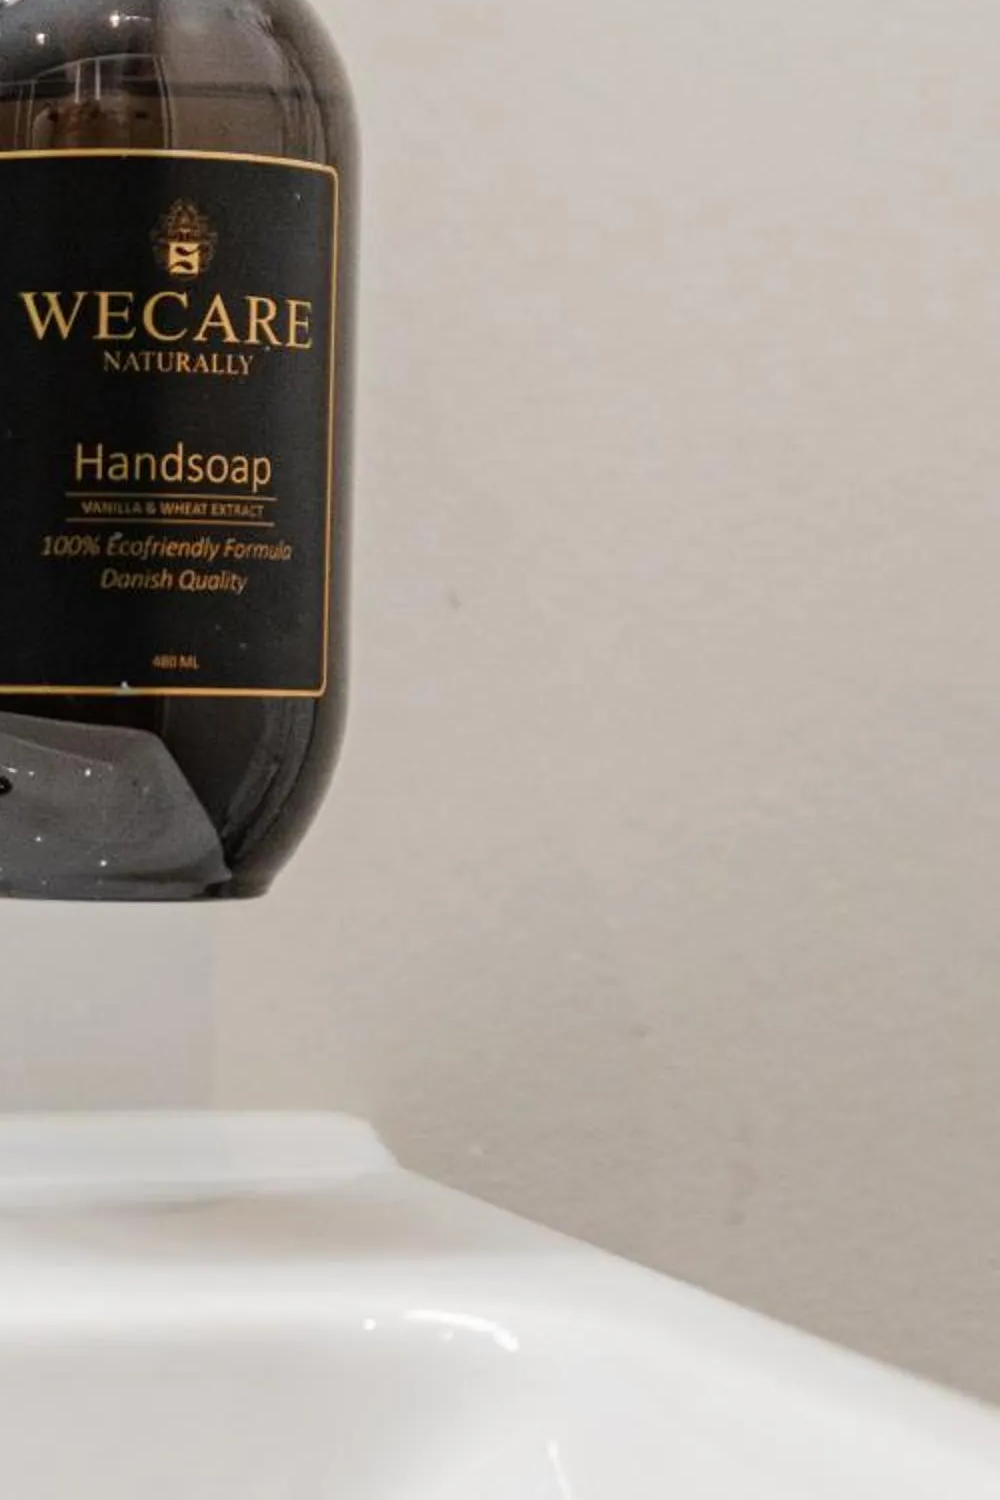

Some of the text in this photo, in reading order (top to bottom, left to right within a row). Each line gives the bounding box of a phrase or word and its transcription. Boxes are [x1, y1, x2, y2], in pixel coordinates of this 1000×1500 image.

[19, 291, 314, 349] WECARE
[103, 350, 254, 375] NATURALLY
[75, 441, 272, 492] Handsoap
[82, 501, 143, 515] VANILLA
[160, 502, 208, 516] WHEAT
[212, 503, 265, 518] EXTRACT
[41, 536, 101, 556] 100%
[224, 538, 293, 560] Formula
[101, 568, 248, 595] Danish Quality
[179, 656, 199, 669] ML
